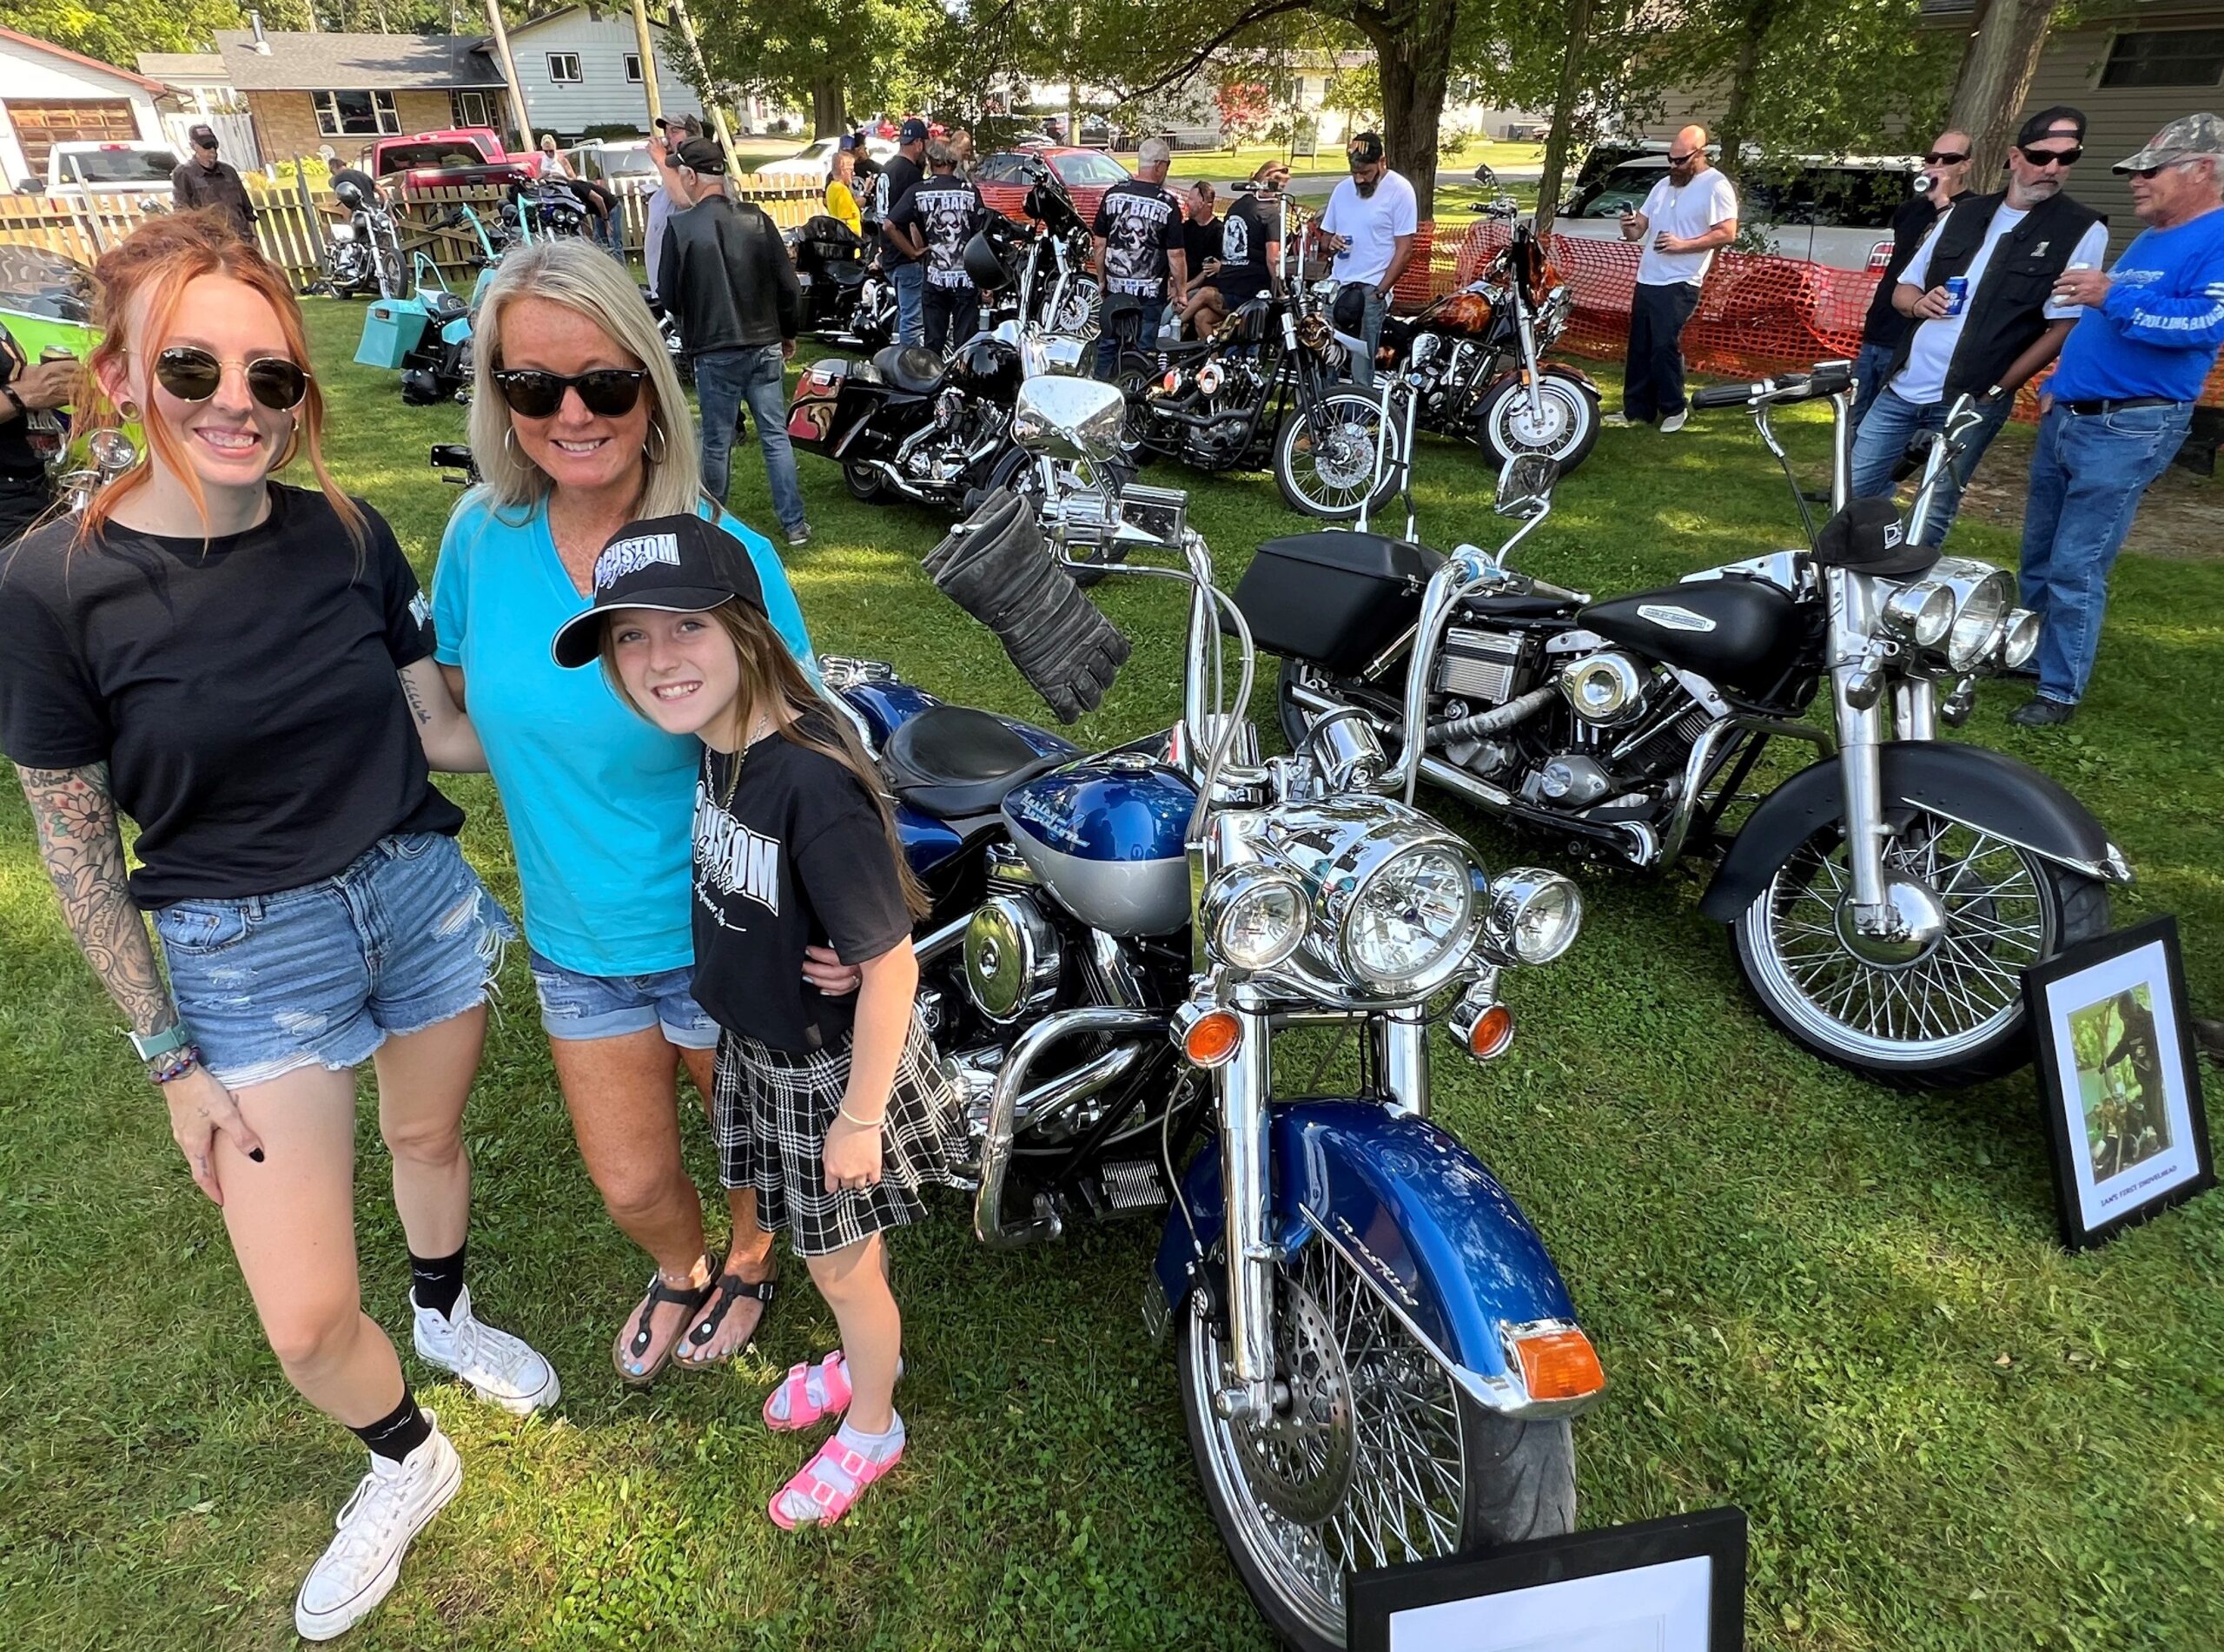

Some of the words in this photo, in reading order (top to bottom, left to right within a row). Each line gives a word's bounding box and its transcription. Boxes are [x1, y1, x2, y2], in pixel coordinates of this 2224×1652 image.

[917, 198, 936, 212] MY
[941, 197, 975, 212] BACK
[1106, 200, 1125, 215] MY
[1130, 202, 1168, 225] BACK
[2120, 1183, 2137, 1199] FIRST
[2138, 1165, 2178, 1189] SHOVELHEAD
